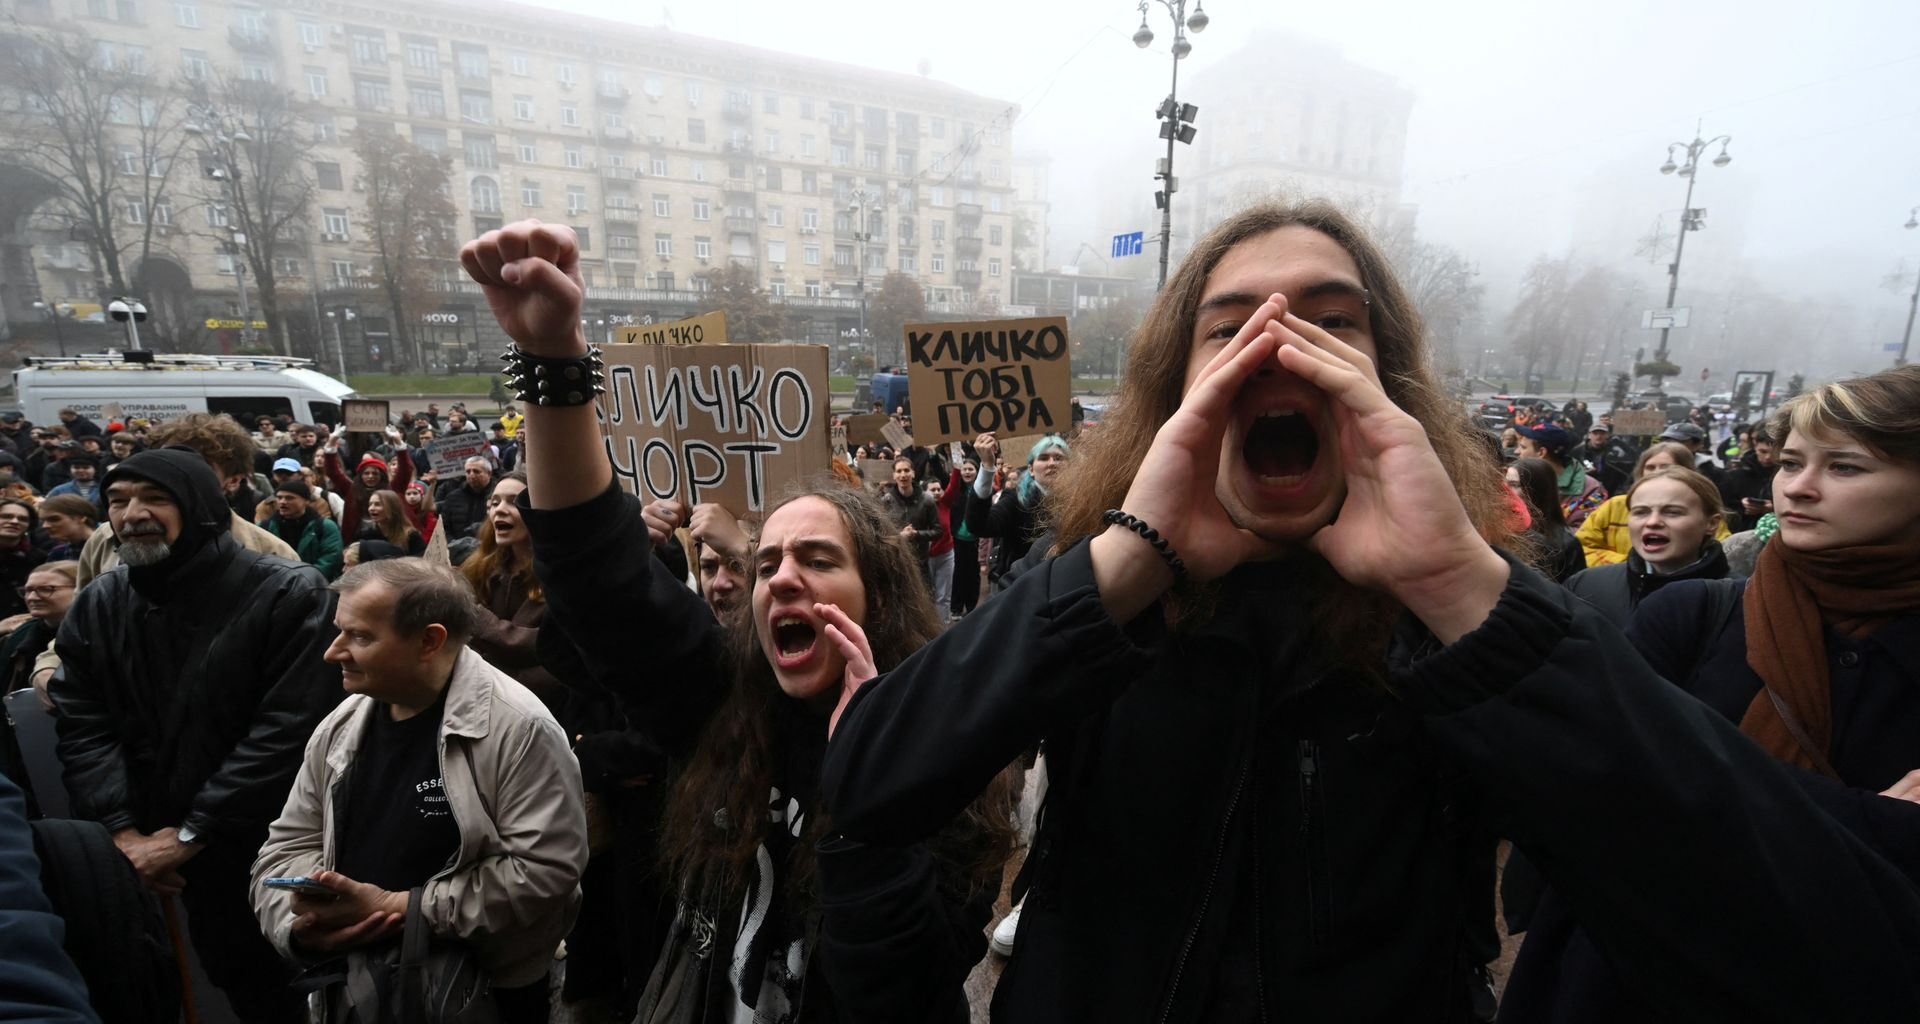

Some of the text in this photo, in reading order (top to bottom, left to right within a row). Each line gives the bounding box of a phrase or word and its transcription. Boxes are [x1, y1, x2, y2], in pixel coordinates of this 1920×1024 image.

[421, 313, 459, 324] MOYO
[908, 325, 1067, 367] КЛИЧКО
[595, 364, 813, 441] ЛИЧКО
[934, 365, 1036, 400] ТОБІ
[937, 397, 1053, 435] ПОРА
[605, 435, 781, 512] ЧОРТ
